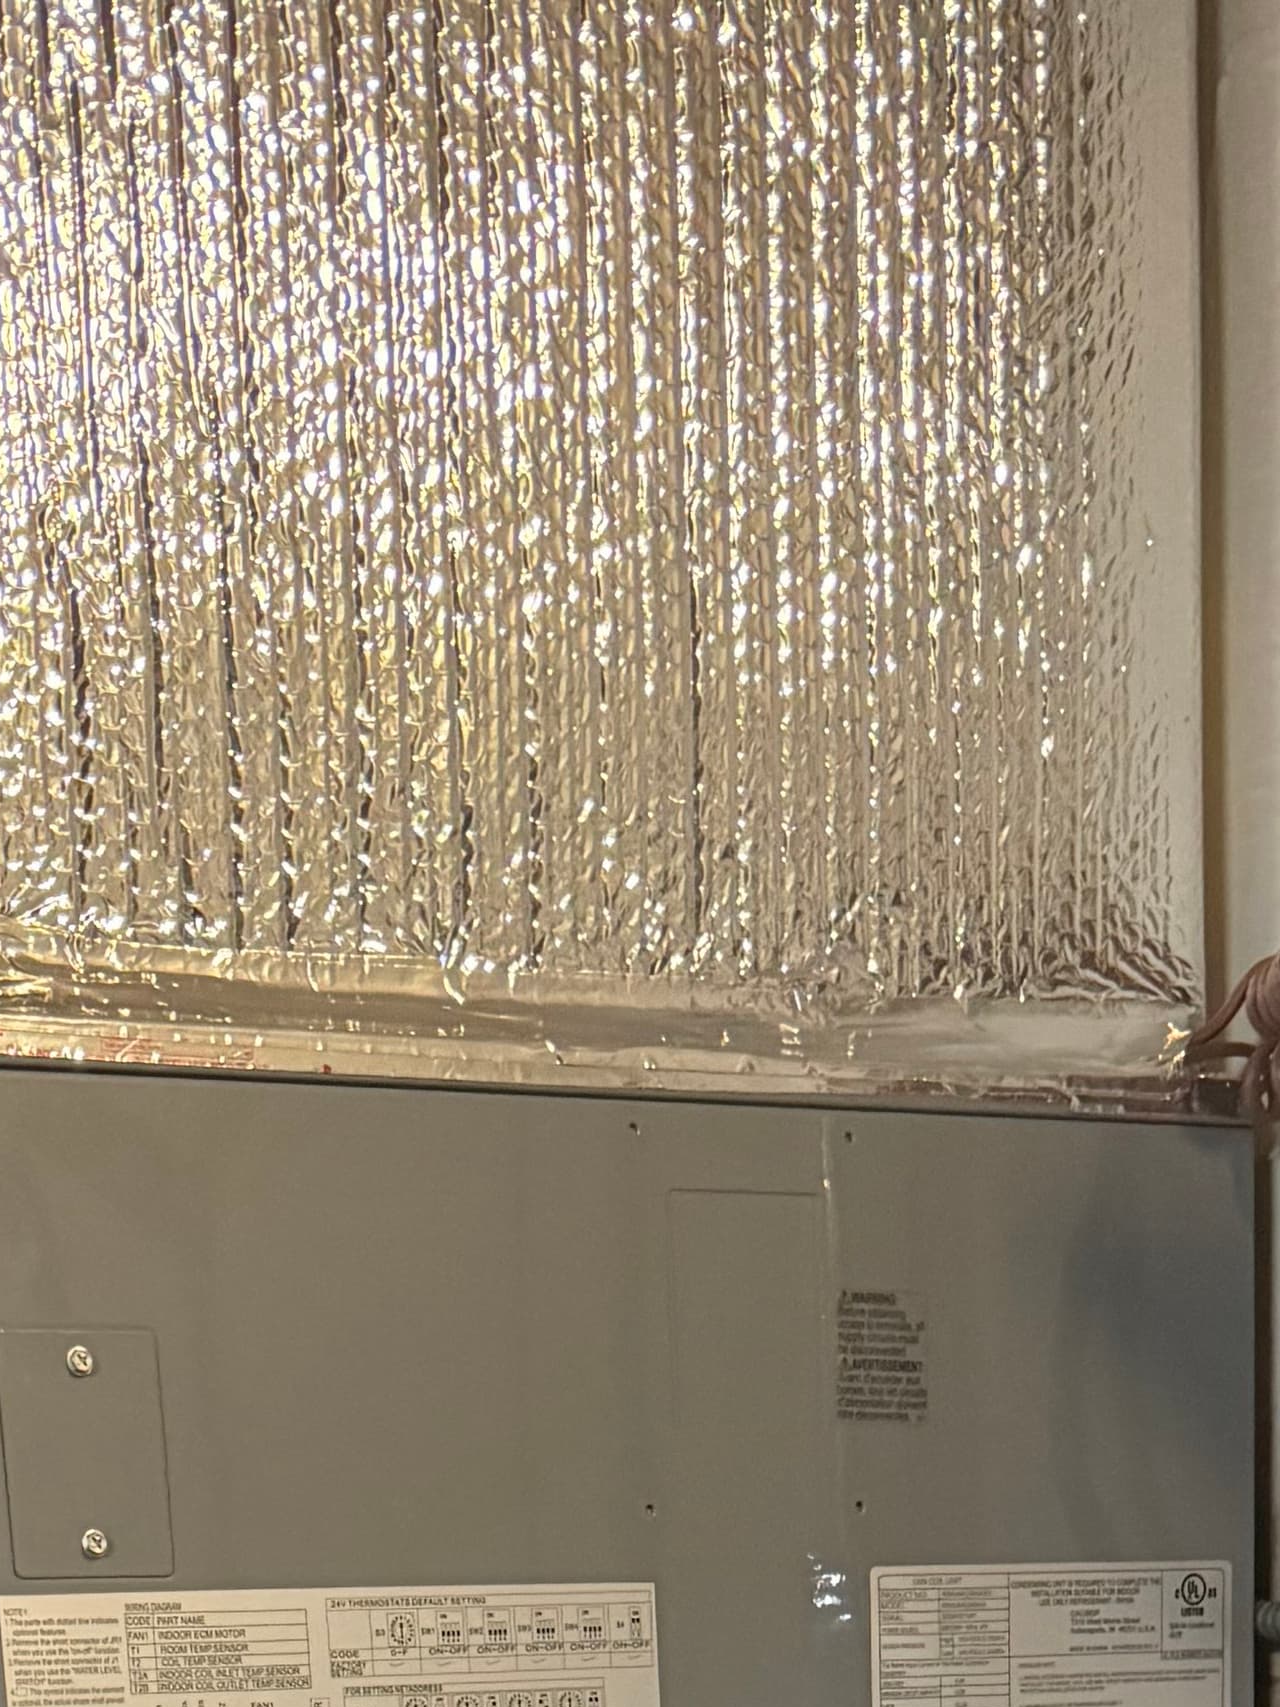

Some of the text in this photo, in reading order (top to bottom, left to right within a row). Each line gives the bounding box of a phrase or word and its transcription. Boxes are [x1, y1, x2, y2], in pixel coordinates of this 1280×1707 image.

[1187, 1580, 1200, 1599] UL
[126, 1615, 205, 1626] CODE PART NAME
[158, 1630, 192, 1639] INDOOR
[218, 1629, 246, 1638] MOTOR
[210, 1643, 249, 1652] SENSOR
[330, 1650, 360, 1659] CODE
[207, 1655, 242, 1664] SENSOR
